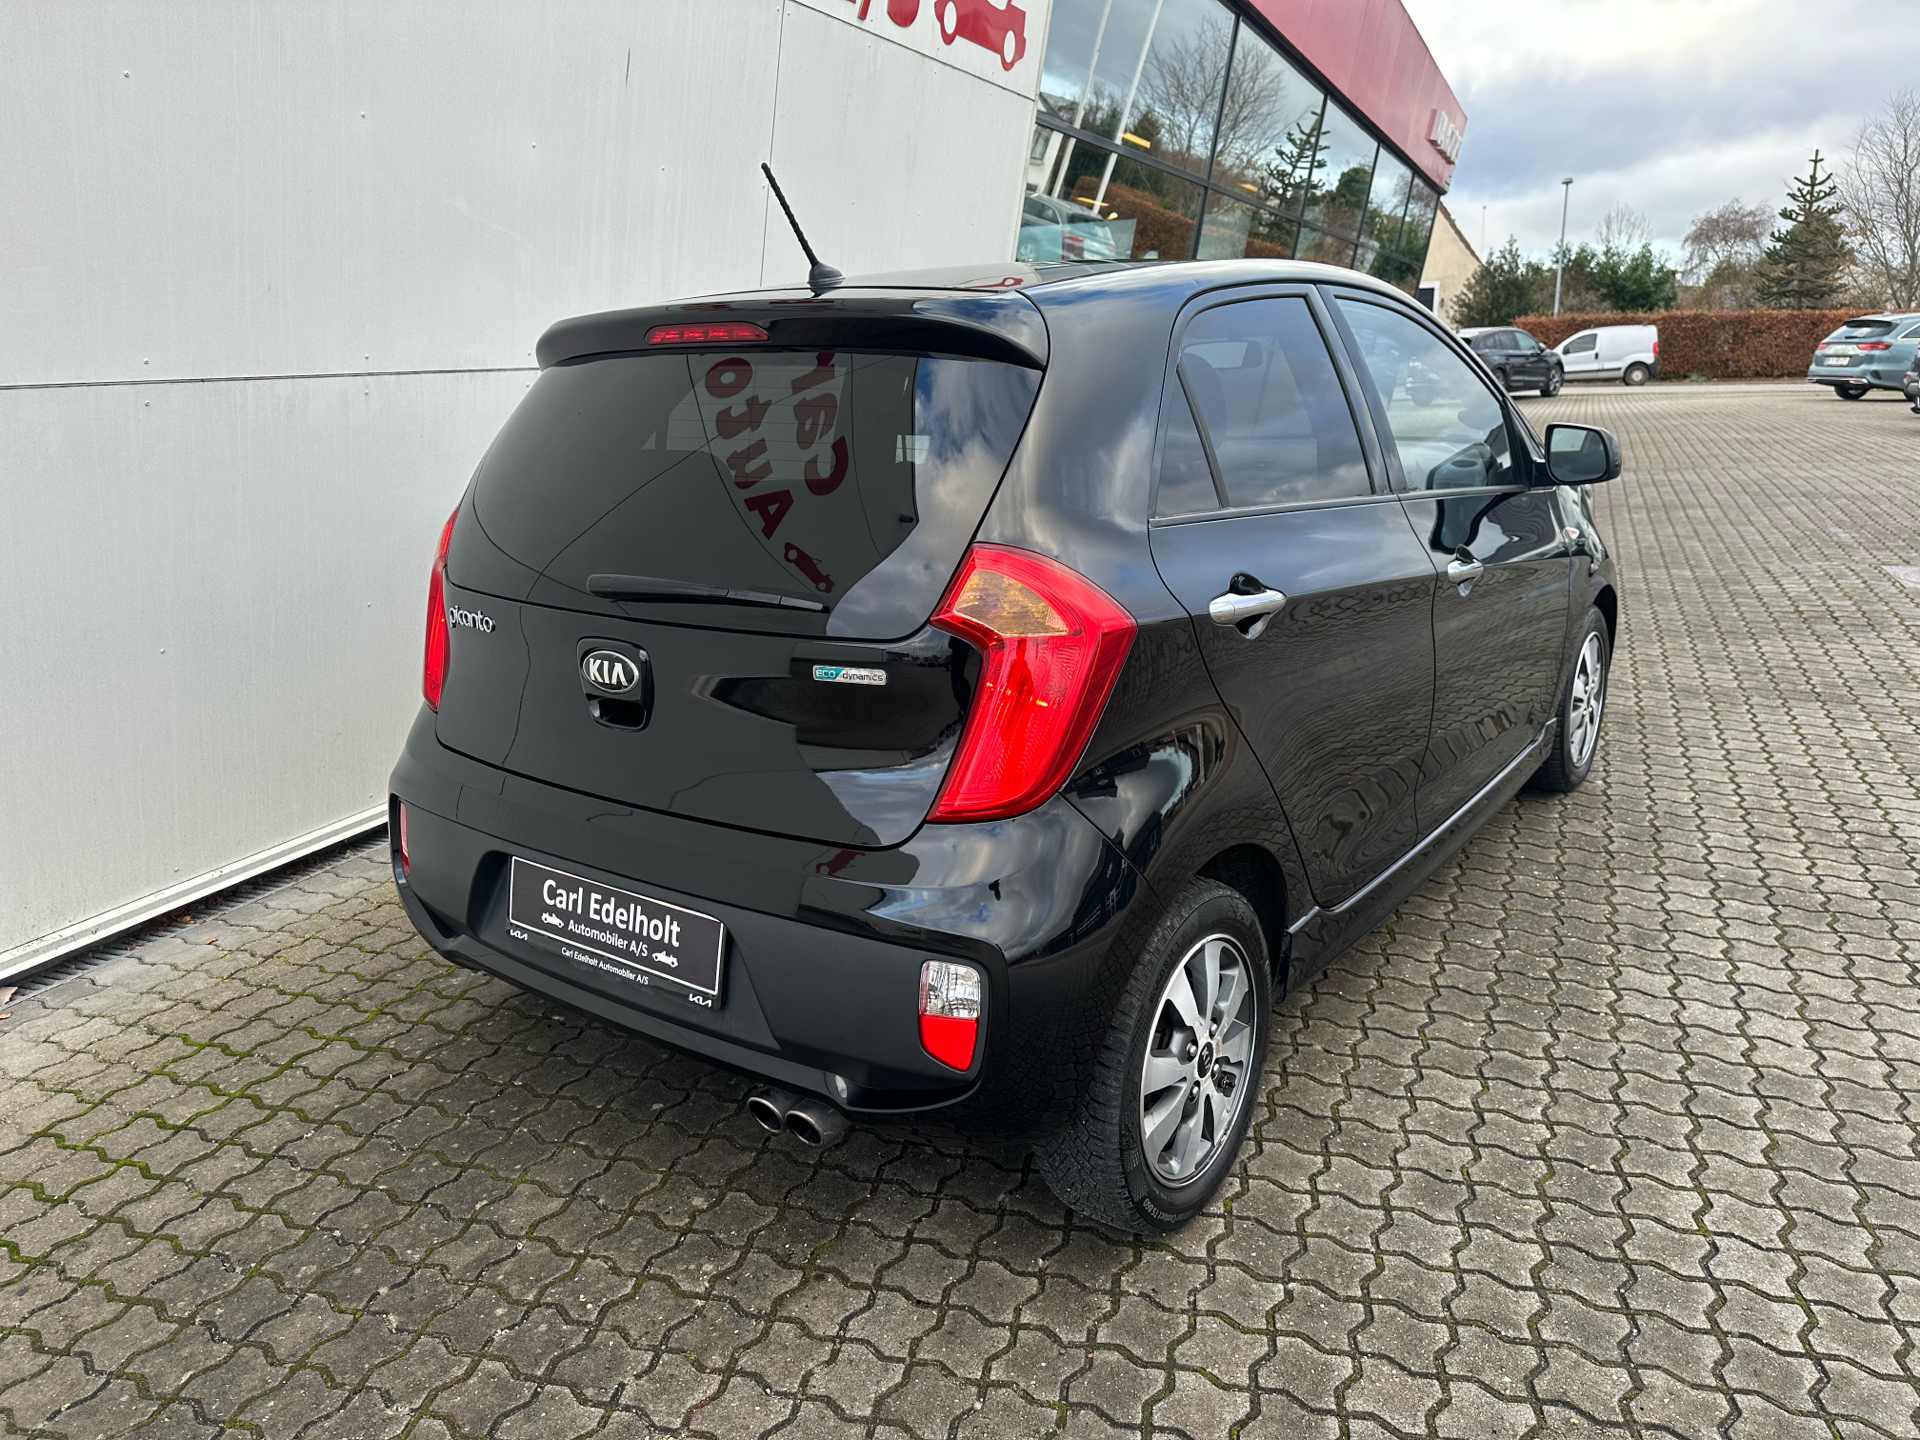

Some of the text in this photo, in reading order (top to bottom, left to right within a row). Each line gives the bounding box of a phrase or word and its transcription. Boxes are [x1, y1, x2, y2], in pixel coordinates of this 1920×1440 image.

[449, 605, 493, 633] picanto
[589, 657, 629, 687] KIA
[815, 669, 884, 682] ECO dynamics
[542, 879, 681, 948] Carl Edelholt
[568, 919, 649, 957] Automobiler A/S
[561, 946, 649, 985] Carl Edelholt Automobiler A/S
